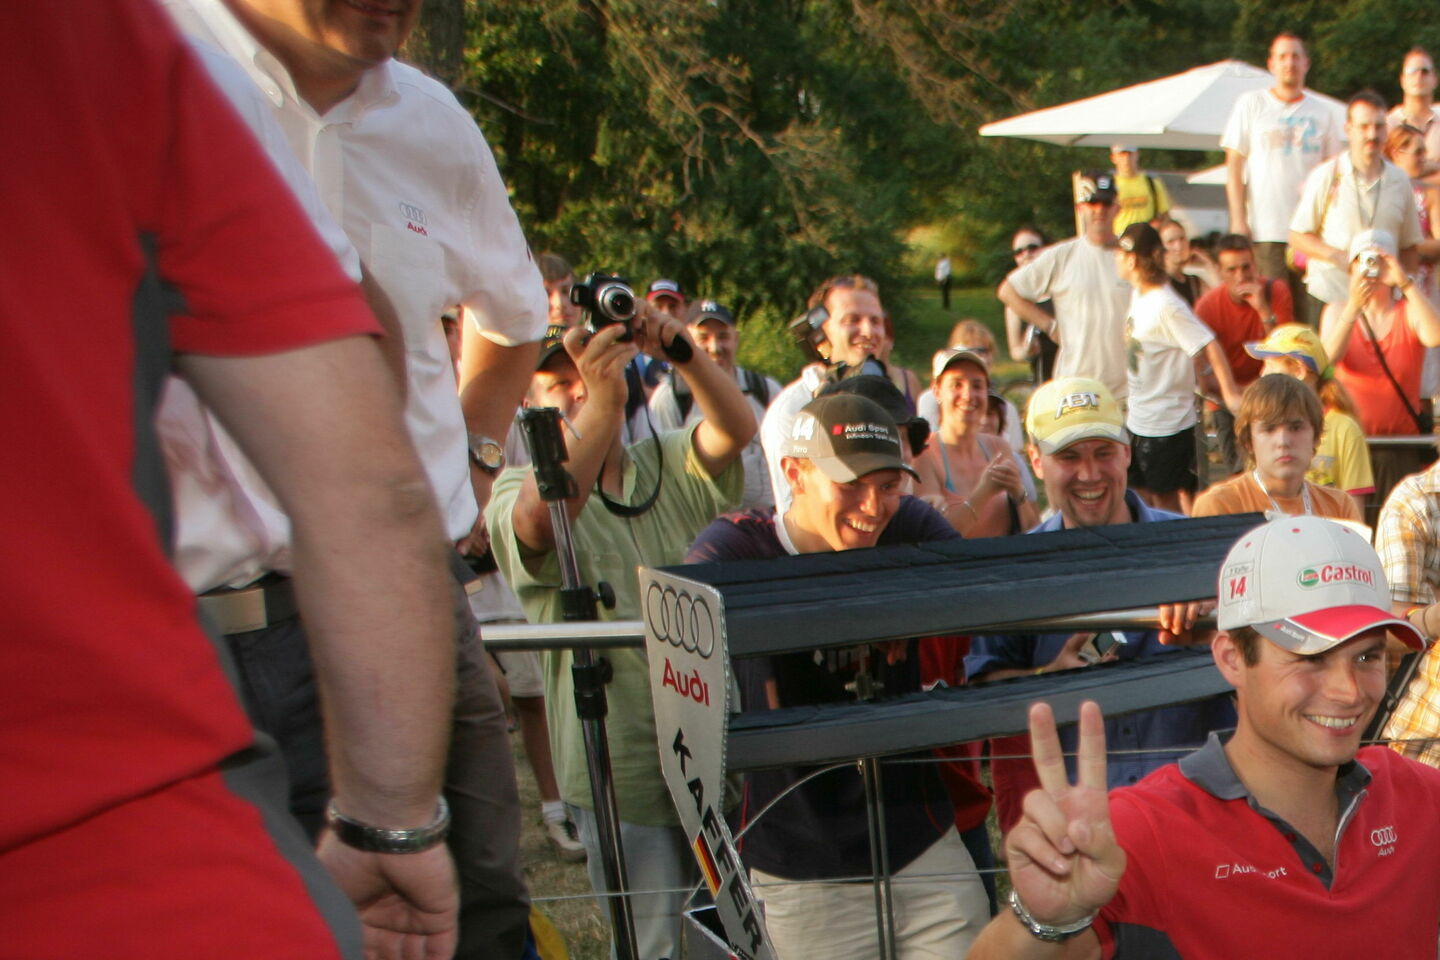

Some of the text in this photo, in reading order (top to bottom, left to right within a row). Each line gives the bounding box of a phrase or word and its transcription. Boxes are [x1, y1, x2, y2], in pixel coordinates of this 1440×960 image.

[407, 222, 427, 236] Audi
[1056, 391, 1100, 420] ABT
[845, 424, 867, 433] Audi
[1321, 564, 1374, 586] Castrol
[1229, 576, 1247, 600] 14
[662, 657, 710, 706] Audi
[672, 727, 762, 955] KAFFER
